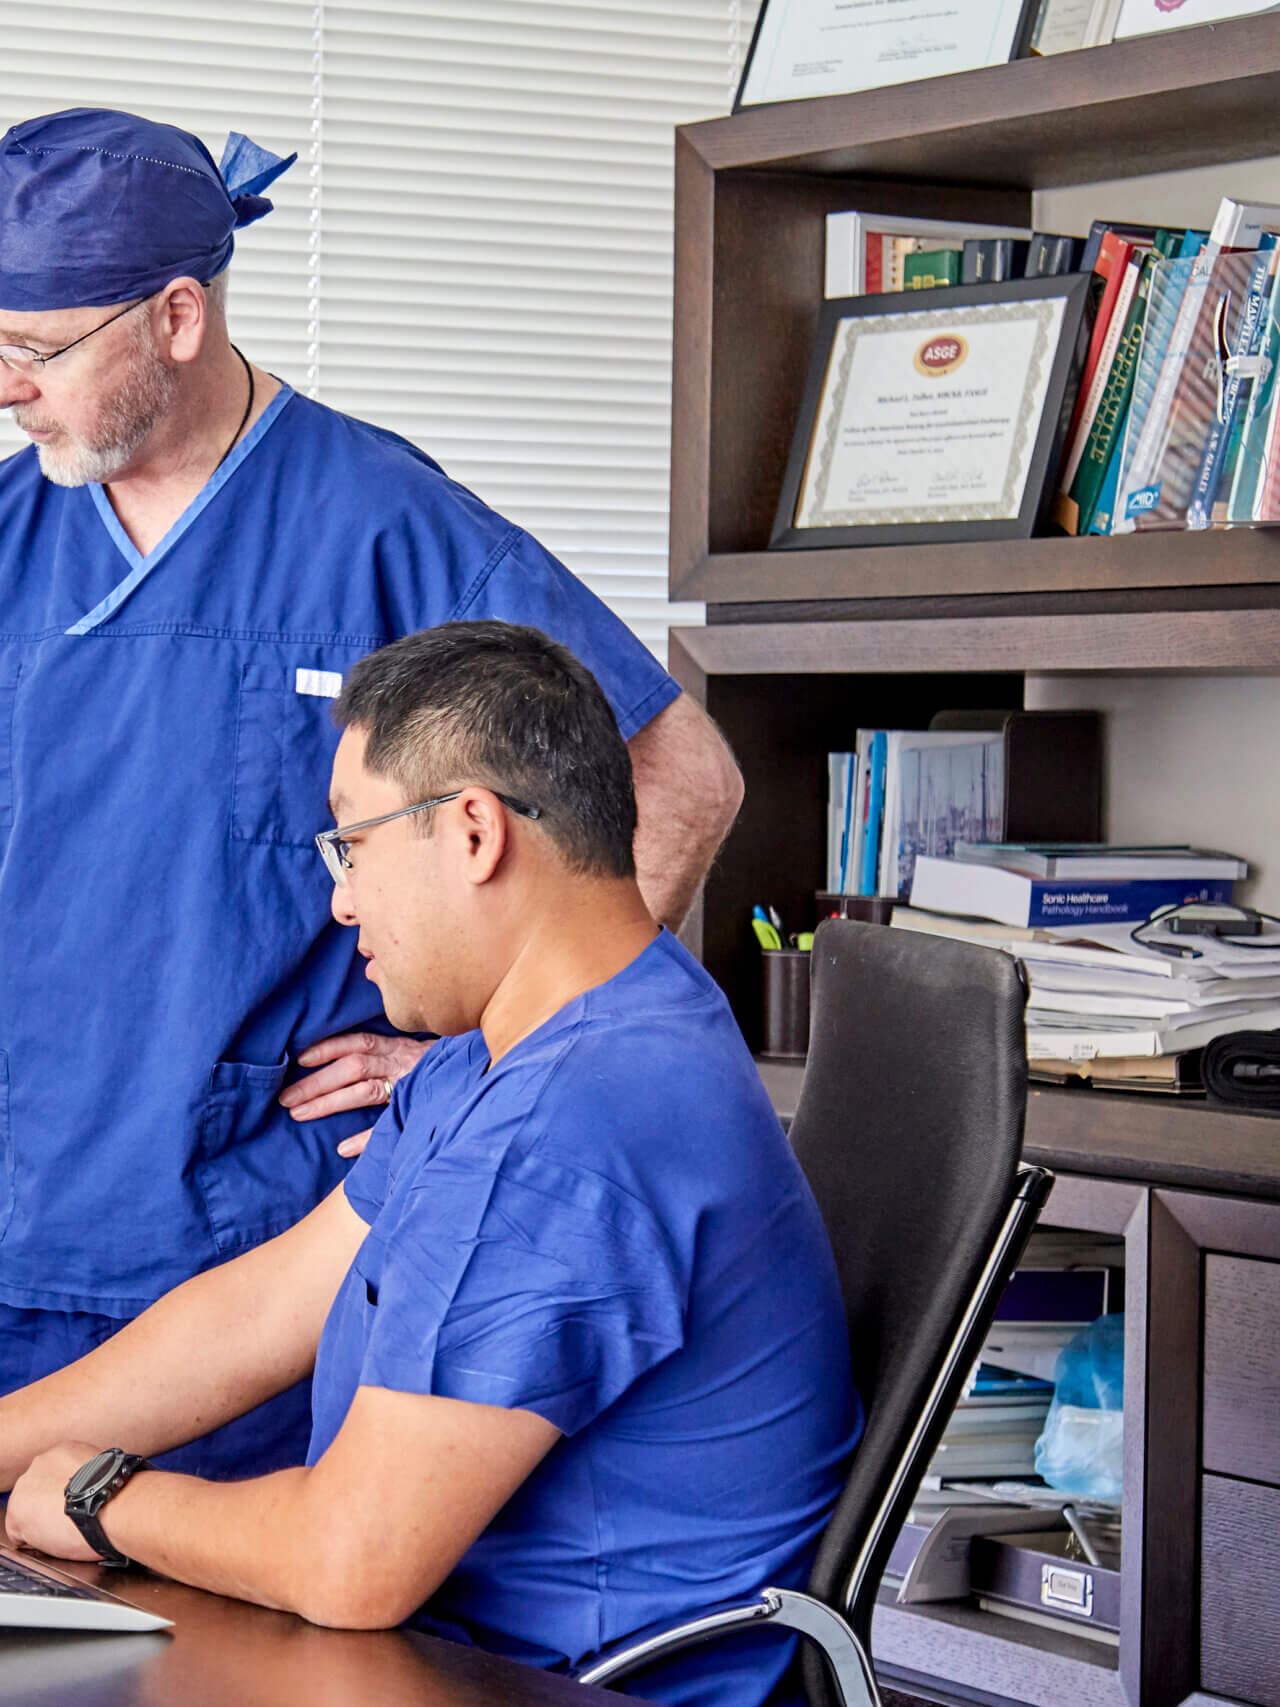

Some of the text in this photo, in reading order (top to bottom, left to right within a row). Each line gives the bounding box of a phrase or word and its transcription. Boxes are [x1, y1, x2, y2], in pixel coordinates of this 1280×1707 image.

[924, 344, 958, 361] ASGE
[1042, 892, 1109, 904] Sonic Healthcare
[1042, 904, 1128, 916] Pathology Handbook
